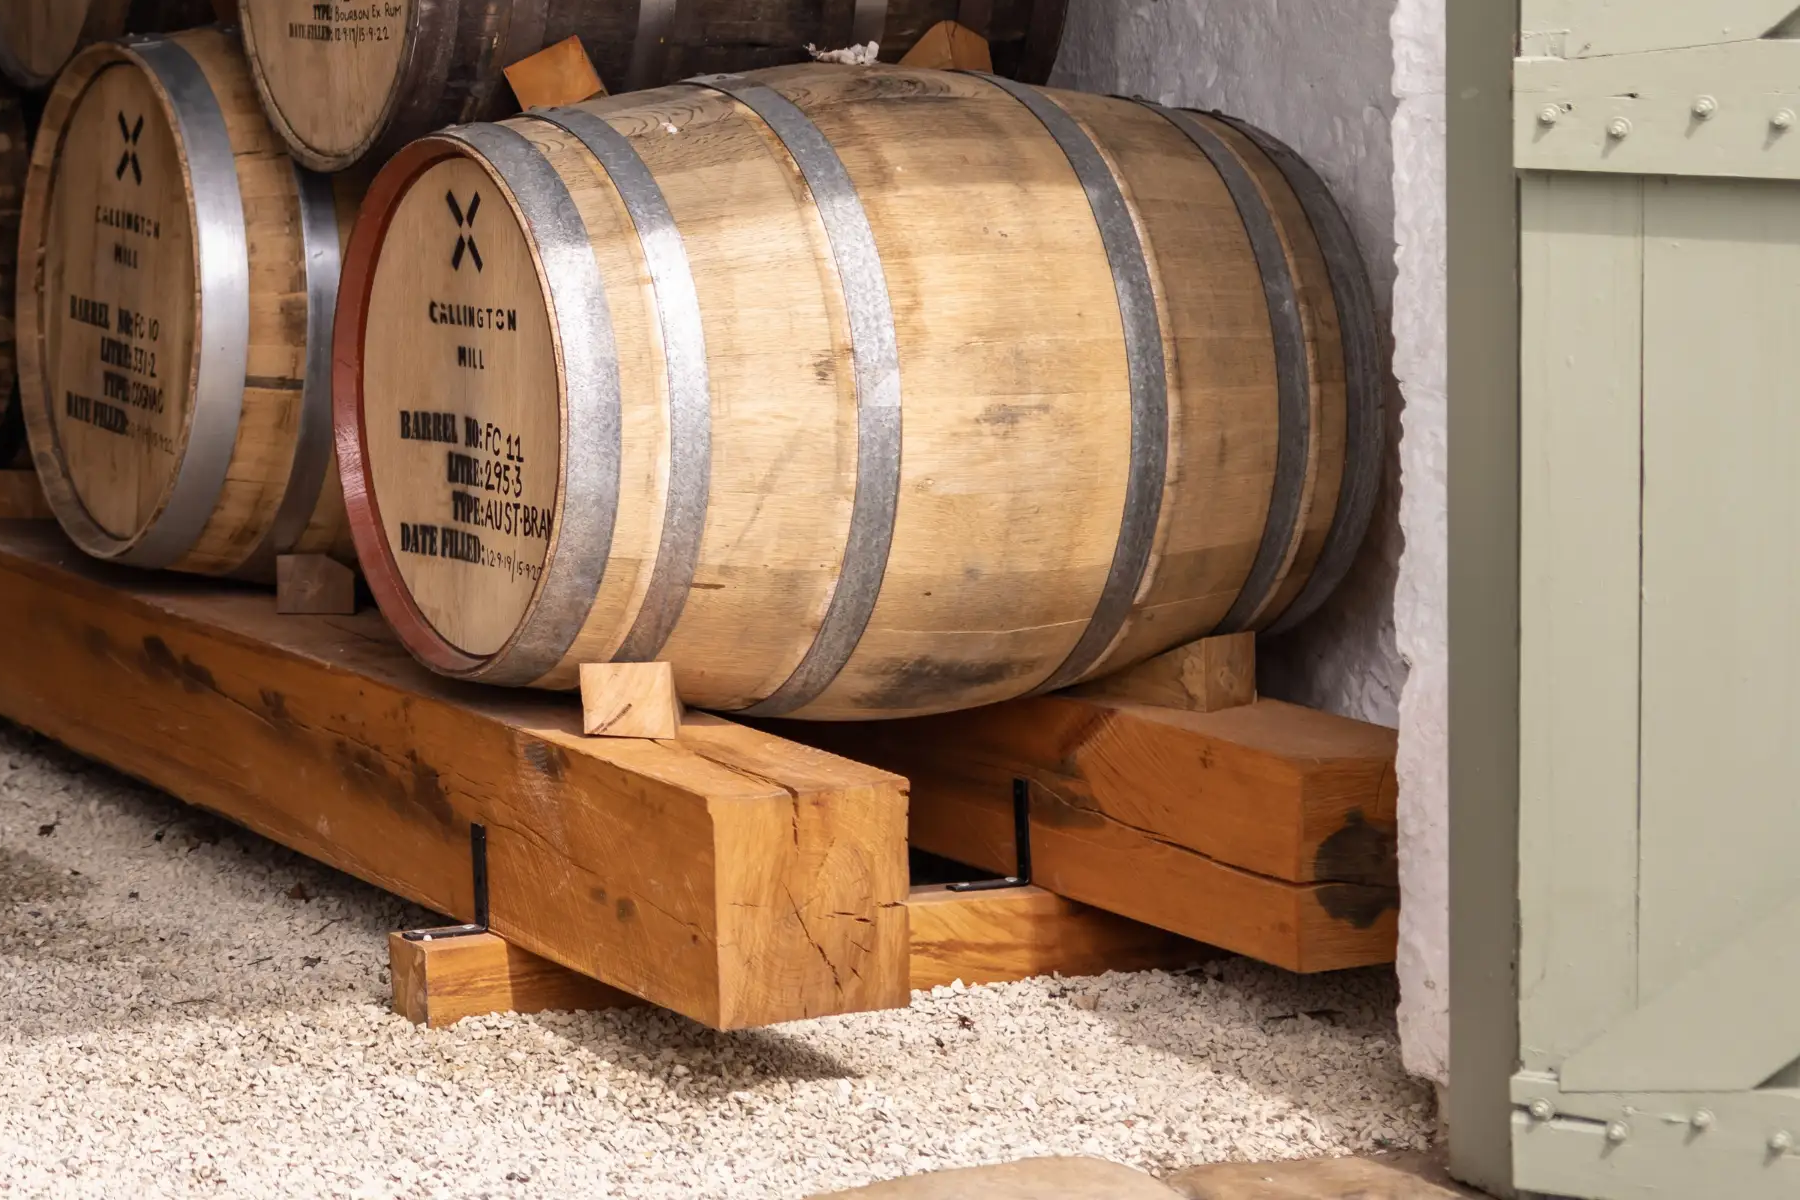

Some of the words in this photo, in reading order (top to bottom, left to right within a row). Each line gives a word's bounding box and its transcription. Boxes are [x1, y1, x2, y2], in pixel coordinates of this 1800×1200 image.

[95, 204, 160, 240] CALLINGTON
[114, 242, 138, 269] MILL
[70, 295, 110, 330] BARREL
[429, 299, 517, 331] CALLINGTON
[457, 346, 484, 370] MILL
[400, 410, 458, 444] BARREL
[464, 415, 482, 449] NO:
[485, 423, 501, 456] FC
[506, 434, 524, 462] 11
[447, 451, 483, 488] LITRE:
[452, 490, 484, 527] TYPE:
[400, 522, 438, 556] DATE
[441, 527, 485, 565] FILLED:
